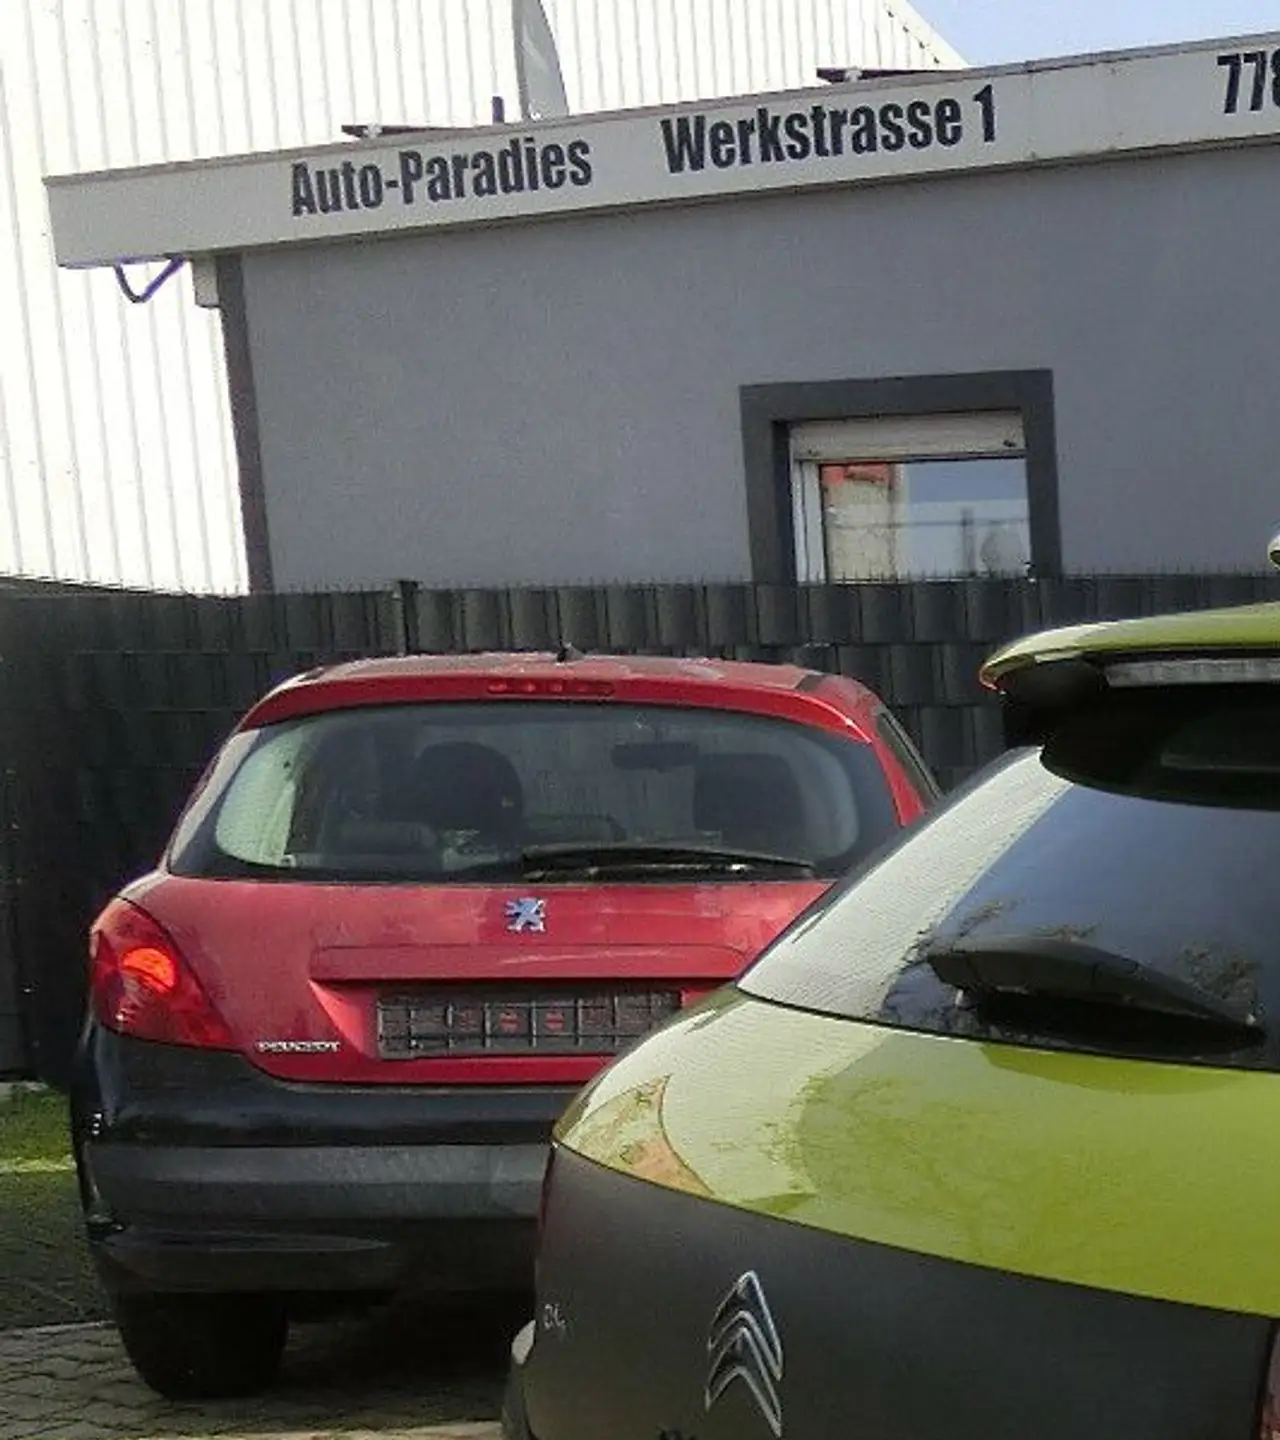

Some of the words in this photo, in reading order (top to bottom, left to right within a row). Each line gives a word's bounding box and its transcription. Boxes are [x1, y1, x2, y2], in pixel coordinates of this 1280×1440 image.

[291, 137, 593, 216] Auto-Paradies
[660, 98, 962, 173] Werkstrasse
[973, 84, 996, 142] 1
